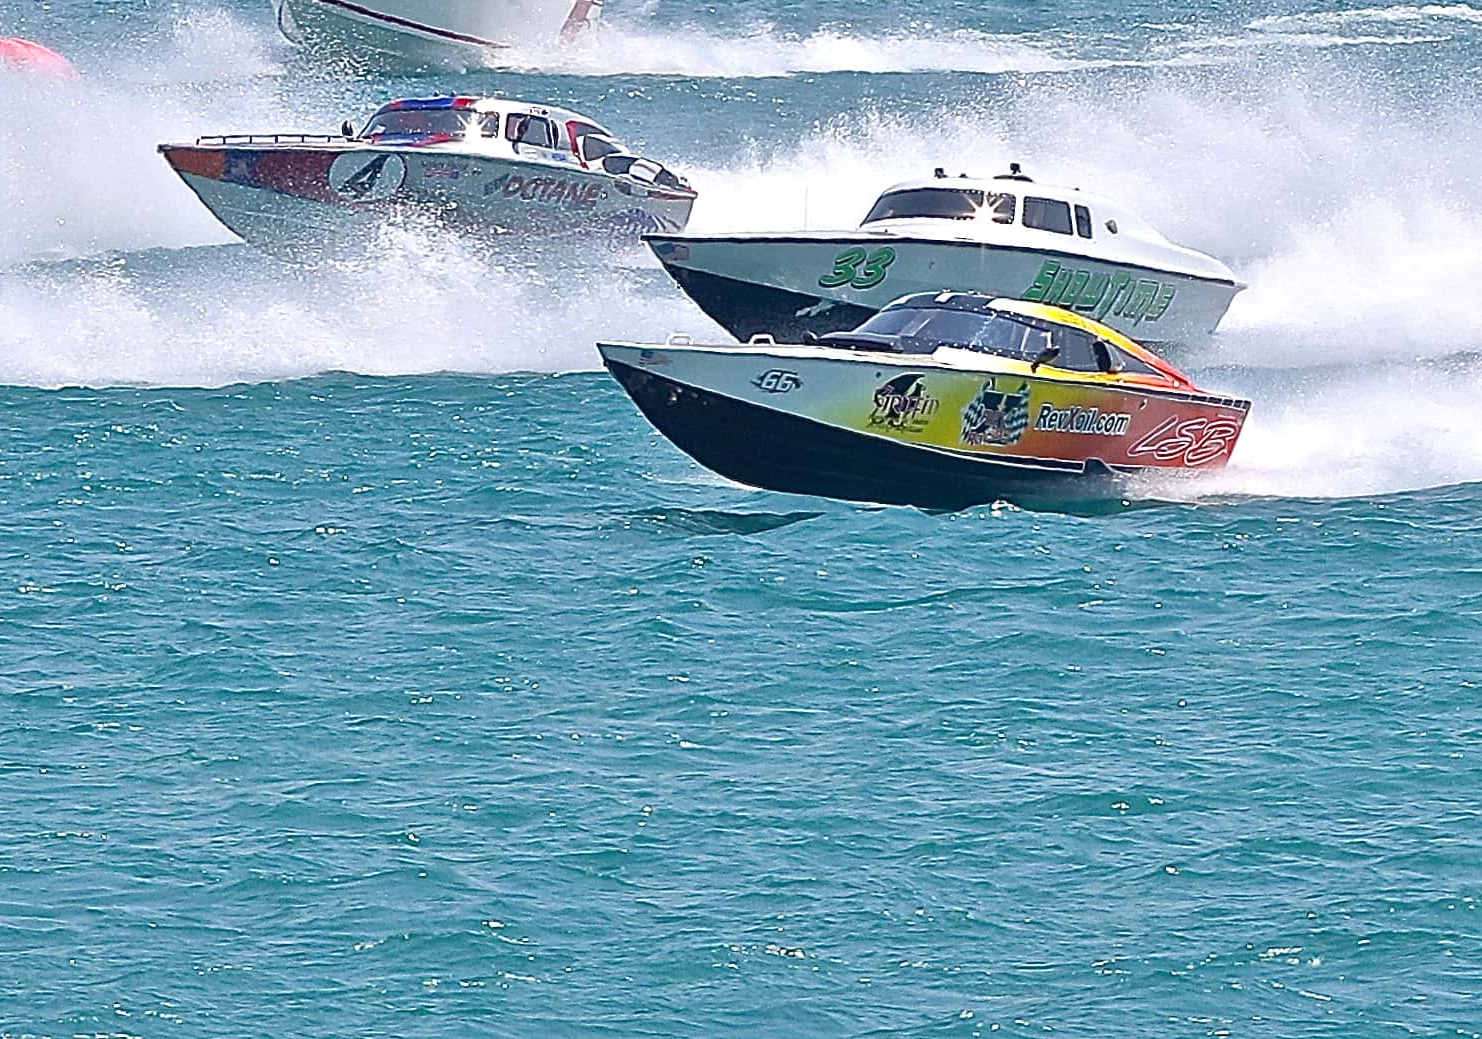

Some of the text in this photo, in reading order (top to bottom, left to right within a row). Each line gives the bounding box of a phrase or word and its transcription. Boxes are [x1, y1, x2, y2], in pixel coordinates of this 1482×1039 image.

[344, 153, 392, 197] 4
[819, 246, 895, 289] 33
[759, 370, 798, 393] 66
[1035, 403, 1132, 436] RevXoil.com
[1127, 415, 1237, 466] LSB
